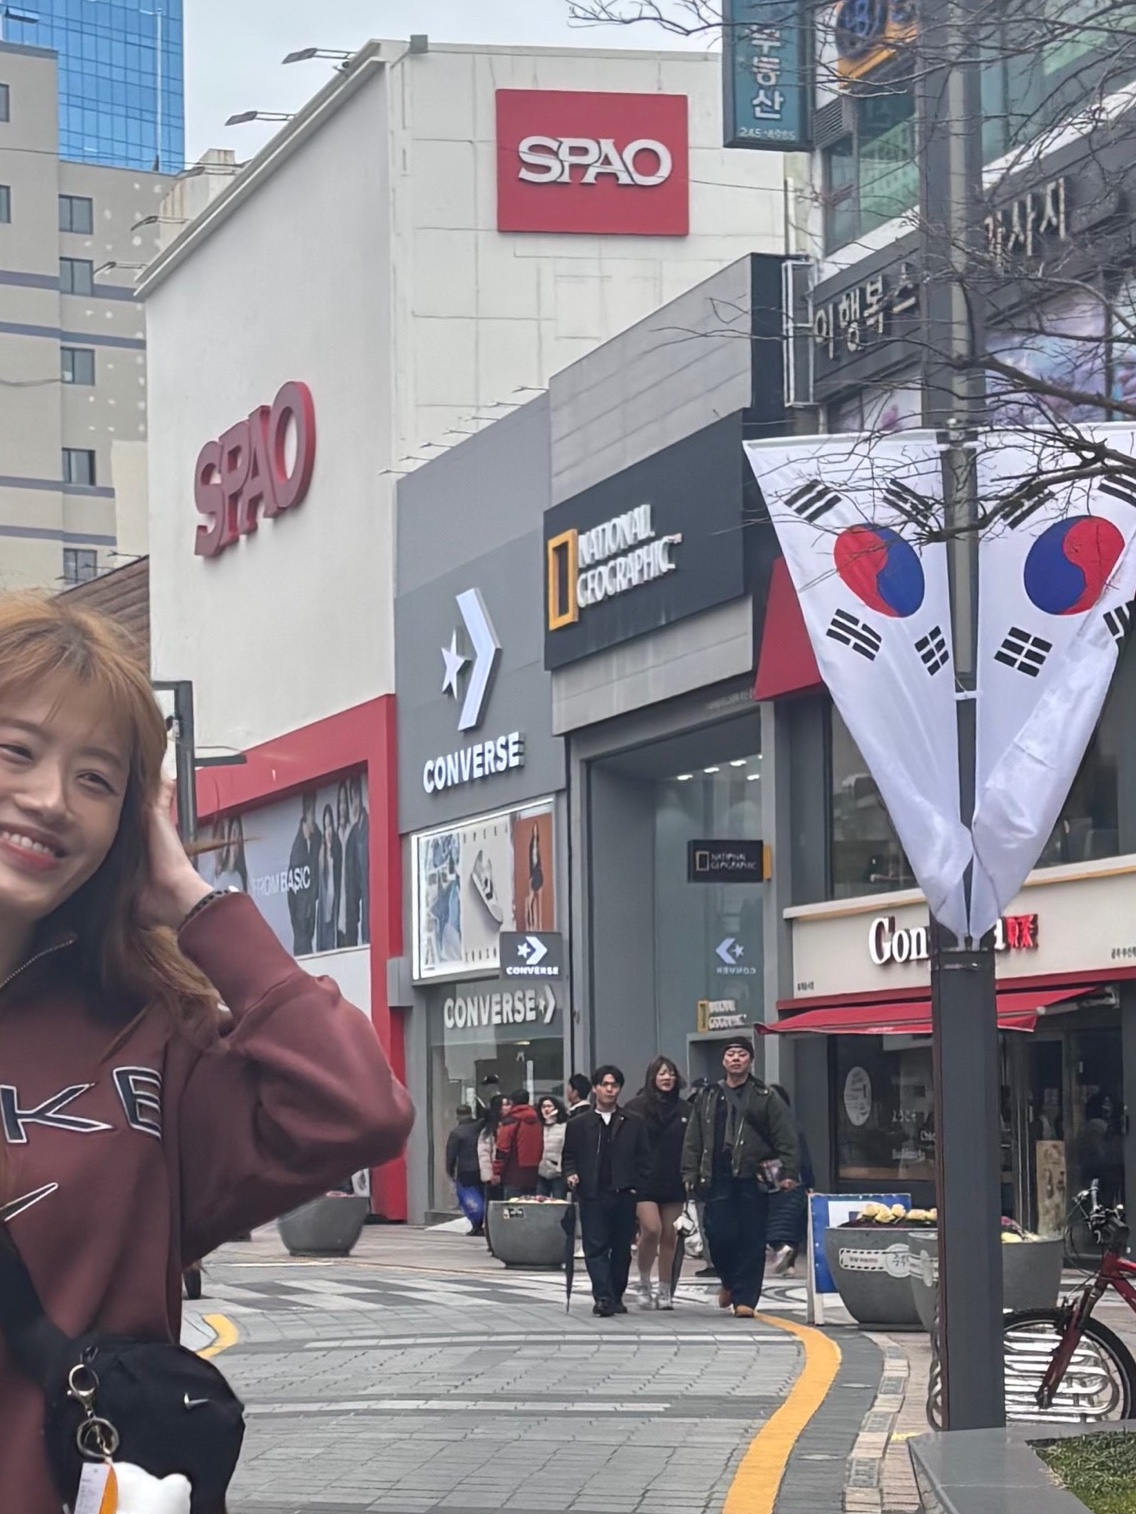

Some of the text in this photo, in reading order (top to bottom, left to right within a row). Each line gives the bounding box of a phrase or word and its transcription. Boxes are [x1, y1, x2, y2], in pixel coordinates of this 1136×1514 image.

[518, 135, 673, 187] SPAO
[194, 380, 316, 559] SPAO
[578, 504, 655, 568] NATIONAL
[576, 535, 676, 608] GEOGRAPHIC
[423, 731, 524, 794] CONVERSE
[280, 866, 311, 894] BASIC
[868, 916, 930, 965] Gon
[506, 966, 559, 976] CONVERSE
[443, 989, 537, 1029] CONVERSE
